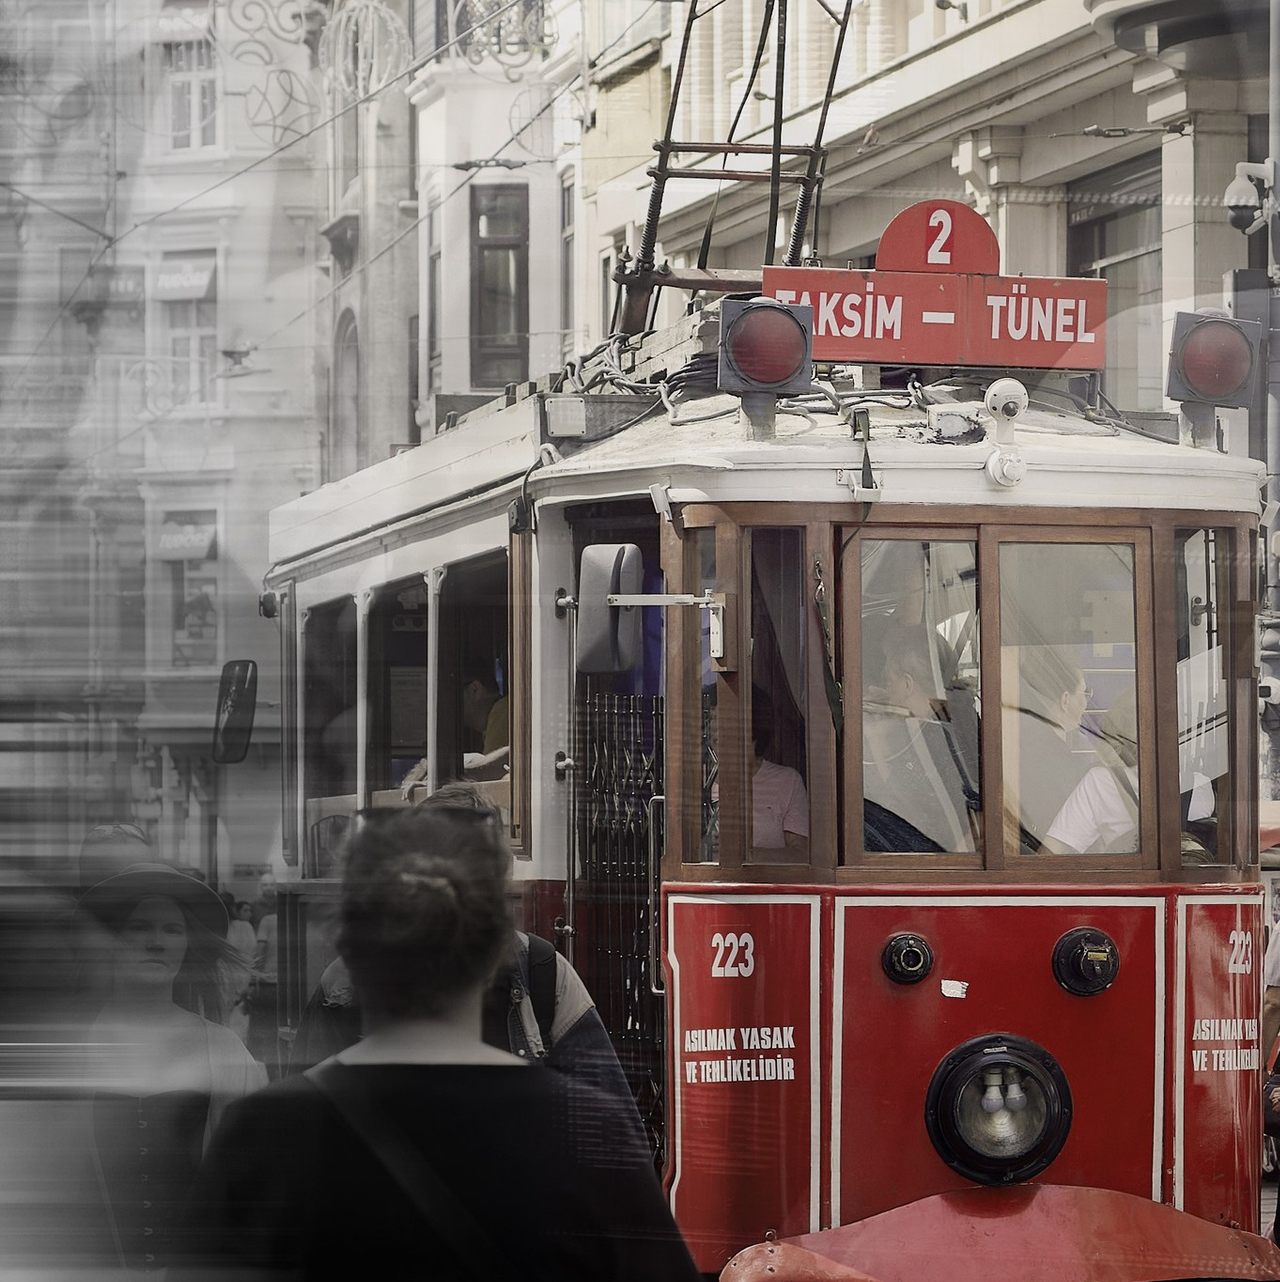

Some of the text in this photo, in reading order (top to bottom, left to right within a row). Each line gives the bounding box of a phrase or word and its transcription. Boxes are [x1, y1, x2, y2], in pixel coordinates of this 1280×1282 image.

[927, 208, 952, 265] 2
[986, 284, 1096, 344] TÜNEL
[711, 932, 755, 978] 223
[1228, 930, 1253, 975] 223
[684, 1026, 796, 1053] ASILMAK YASAK
[1192, 1018, 1243, 1041] ASILMAK
[685, 1054, 796, 1084] VE TEHLİKELİDİR
[1192, 1049, 1208, 1072] VE
